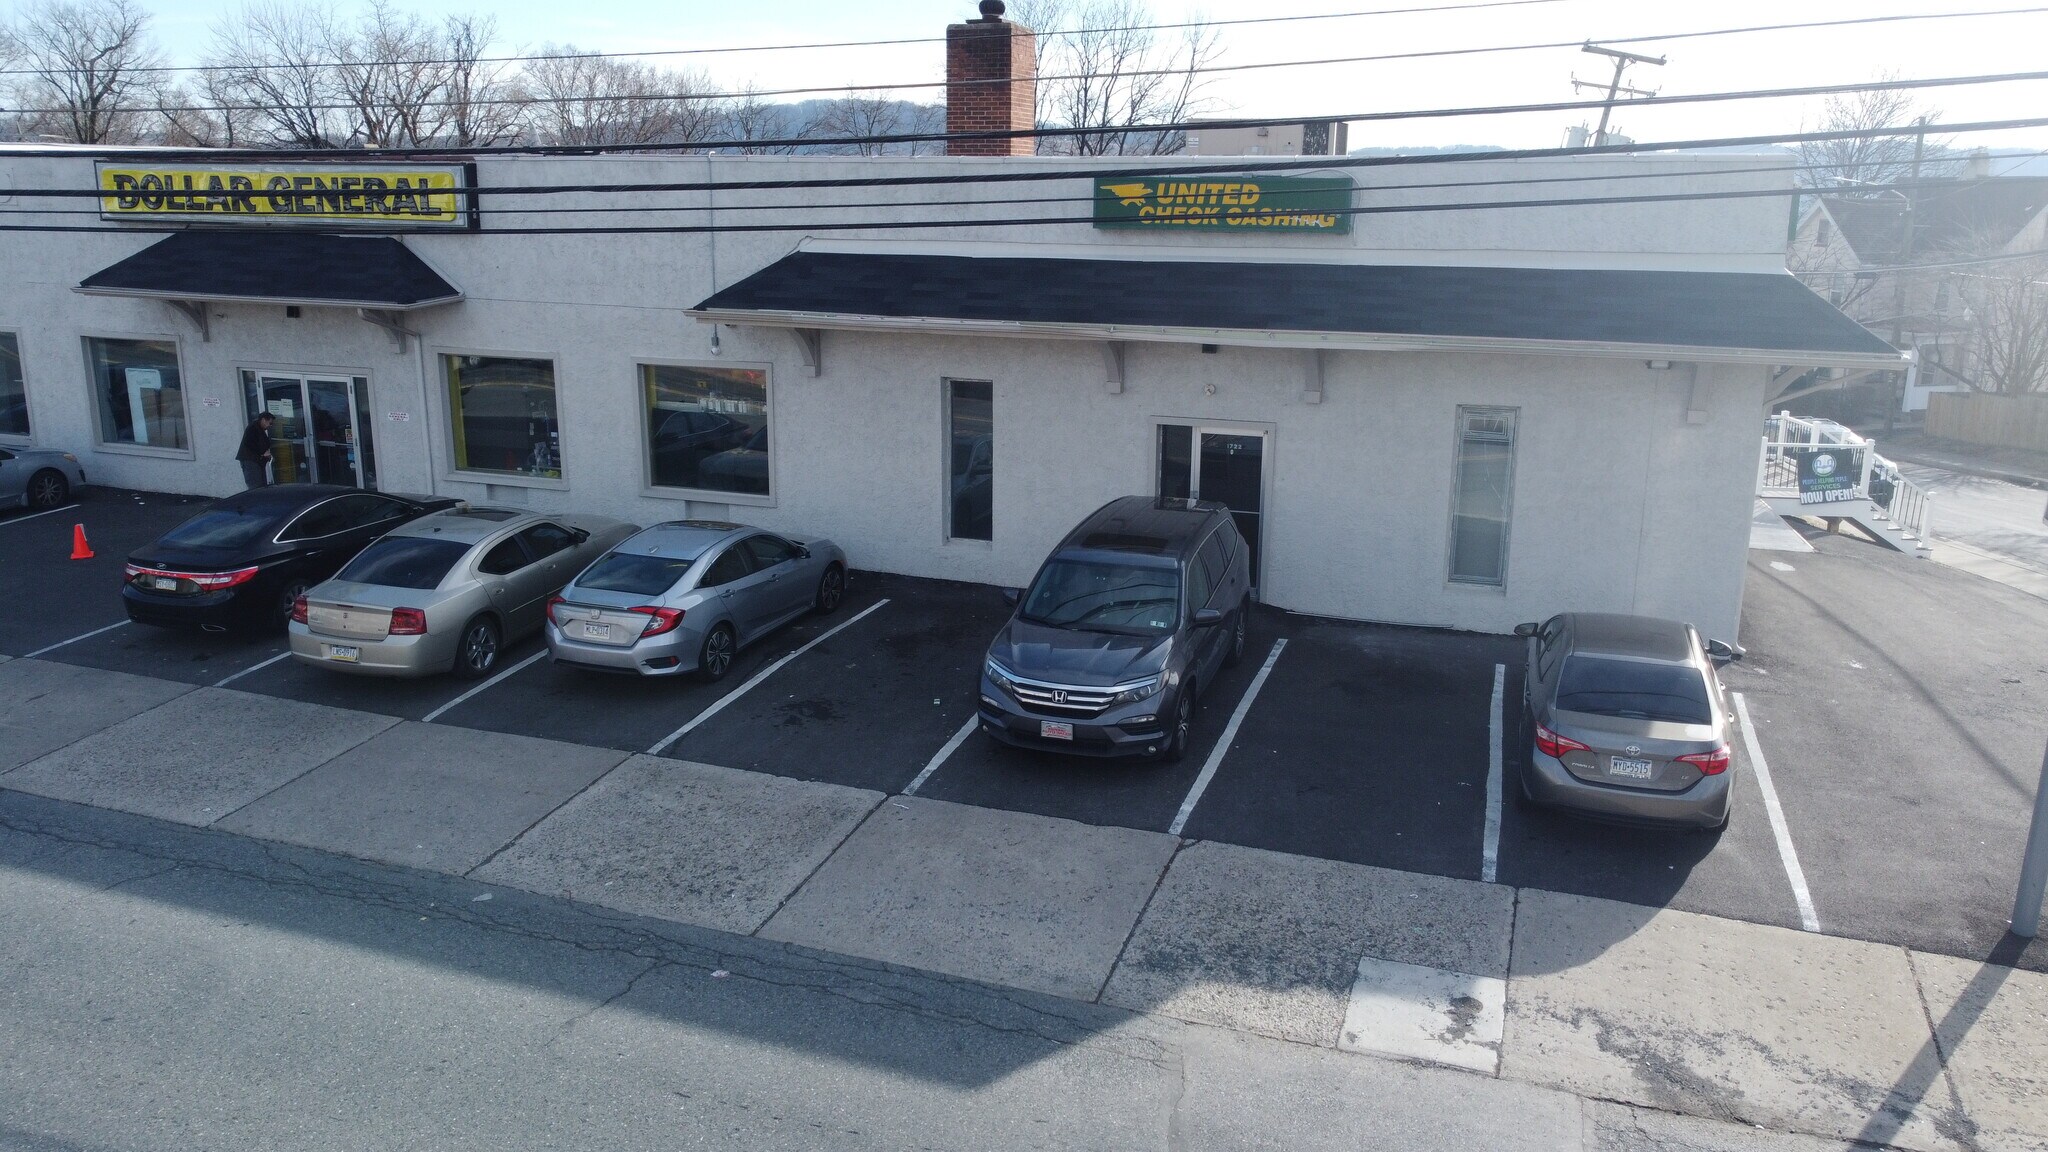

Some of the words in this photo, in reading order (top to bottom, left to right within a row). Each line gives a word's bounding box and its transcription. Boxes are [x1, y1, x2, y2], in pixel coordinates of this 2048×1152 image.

[113, 173, 257, 213] DOLLAR
[267, 175, 442, 216] GENERAL
[1156, 183, 1260, 205] UNITED
[1138, 206, 1219, 225] CHECK
[1225, 207, 1335, 228] CASHING
[1800, 491, 1822, 503] NOW
[1825, 489, 1853, 501] OPEN!
